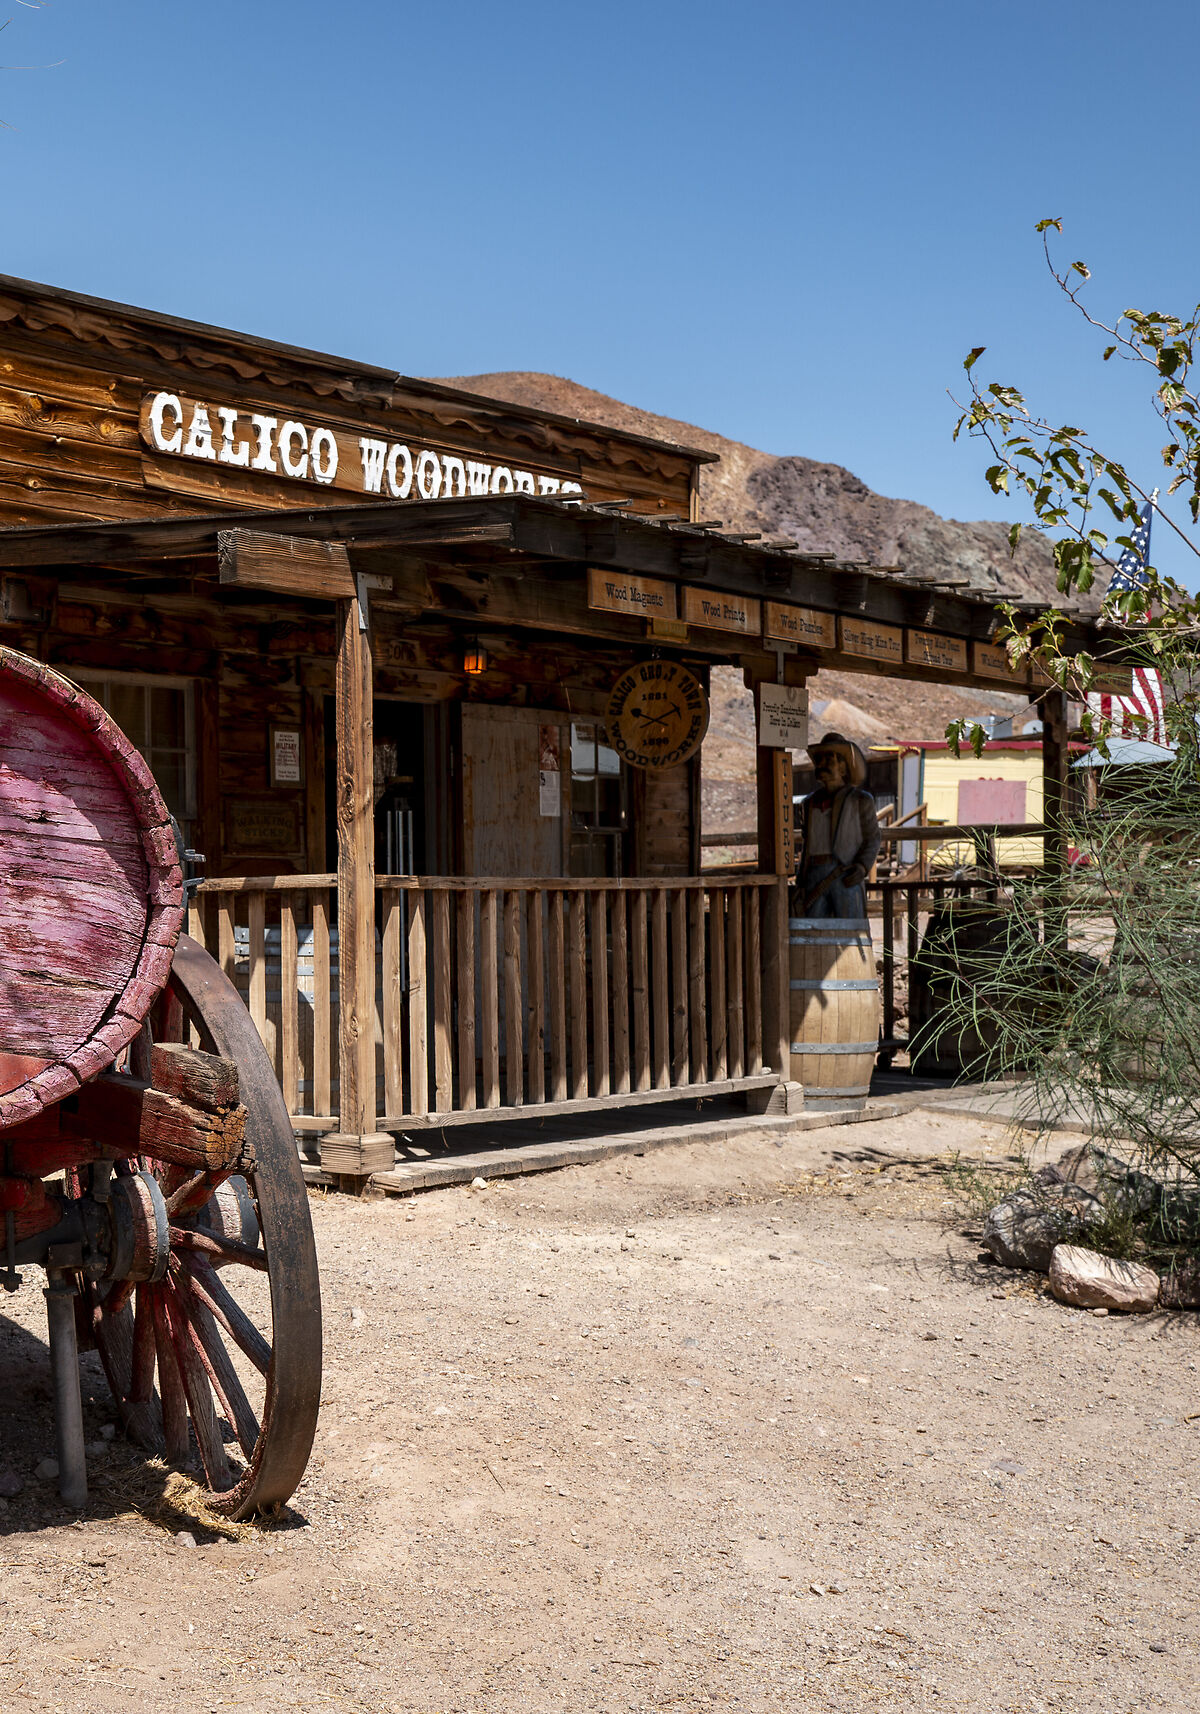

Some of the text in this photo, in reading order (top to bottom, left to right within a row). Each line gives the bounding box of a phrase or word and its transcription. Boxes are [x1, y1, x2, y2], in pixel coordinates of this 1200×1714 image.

[149, 391, 340, 484] CALICO
[604, 582, 664, 608] Wood Magnets
[701, 600, 746, 623] Wood Prints
[780, 614, 798, 631] Wood
[609, 676, 637, 716] CALICO
[678, 676, 702, 710] TOWN
[641, 692, 668, 701] 1881
[276, 742, 297, 750] MILITARY
[611, 714, 702, 766] WOODWORKS
[642, 736, 670, 746] 1896
[235, 815, 293, 829] WALKING
[782, 758, 791, 869] TOURS
[242, 827, 286, 838] STICKS
